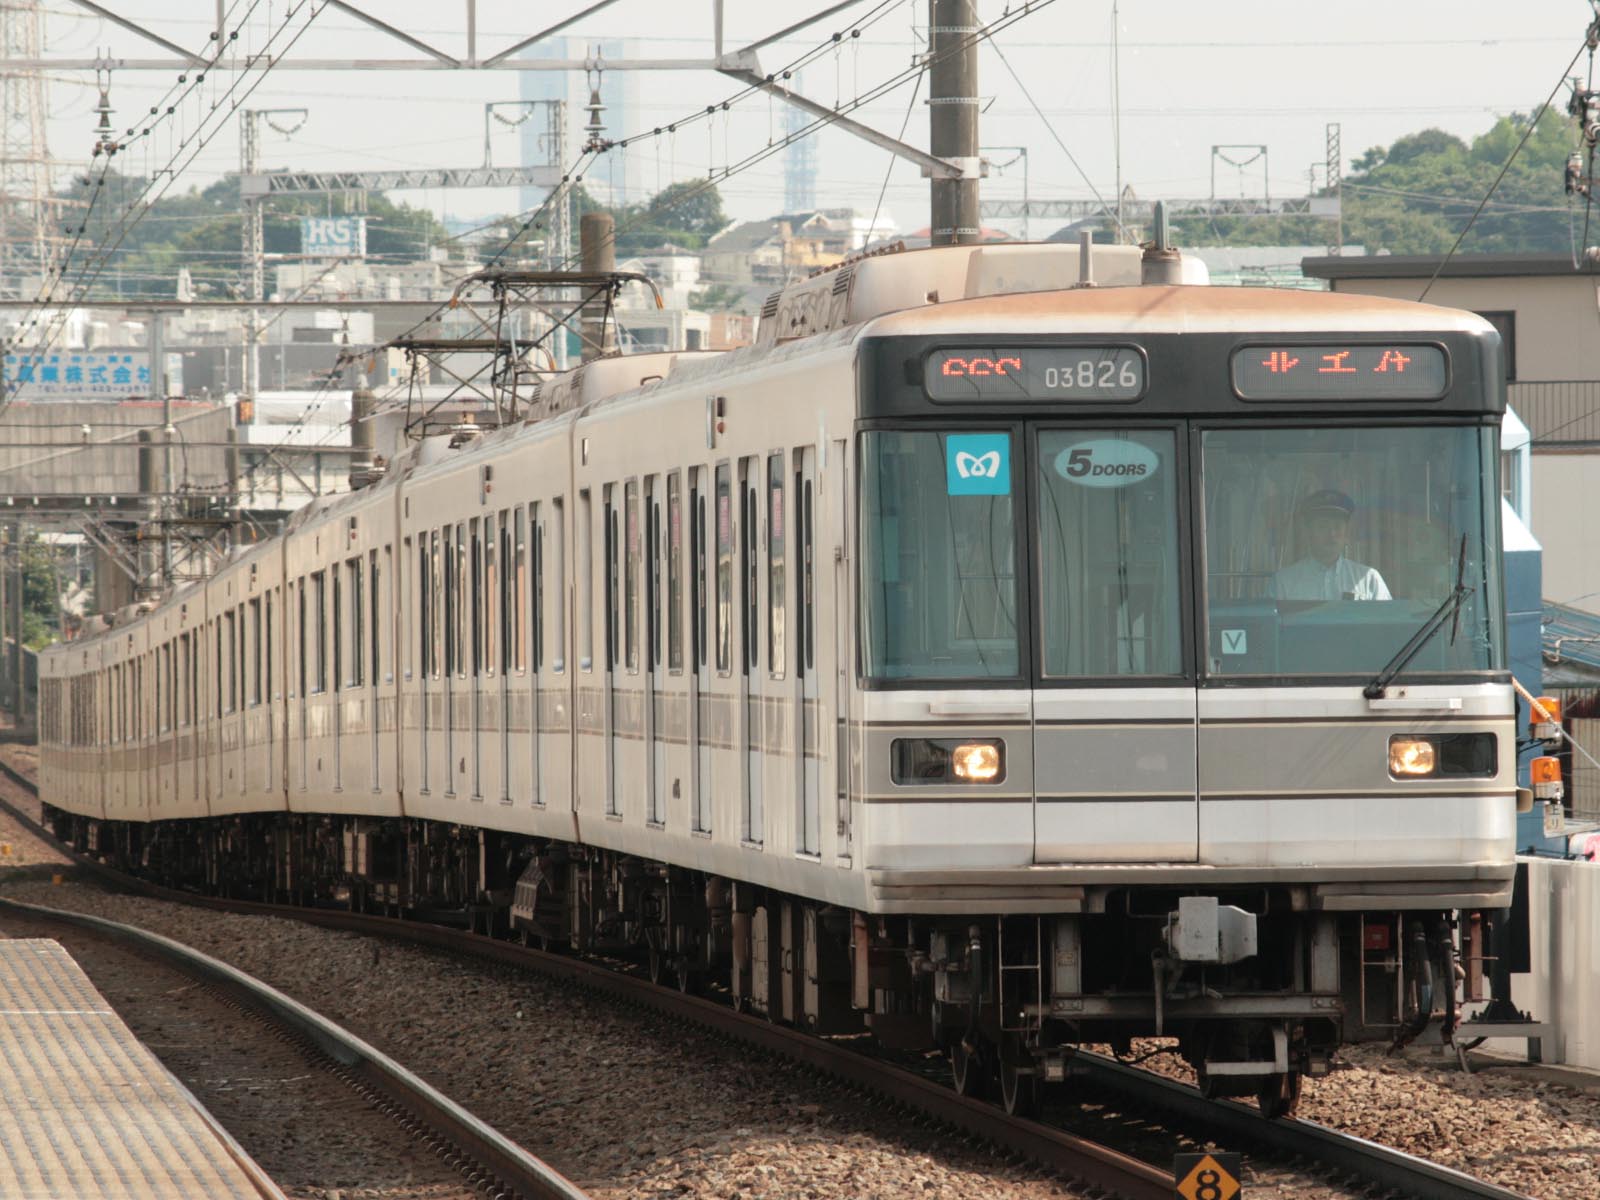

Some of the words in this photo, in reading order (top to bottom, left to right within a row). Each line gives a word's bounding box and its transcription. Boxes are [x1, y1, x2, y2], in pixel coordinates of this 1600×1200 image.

[308, 219, 350, 244] HRS
[1066, 449, 1093, 477] 5
[1092, 464, 1147, 476] DOORS
[1224, 632, 1243, 651] V
[1195, 1169, 1222, 1200] 8
